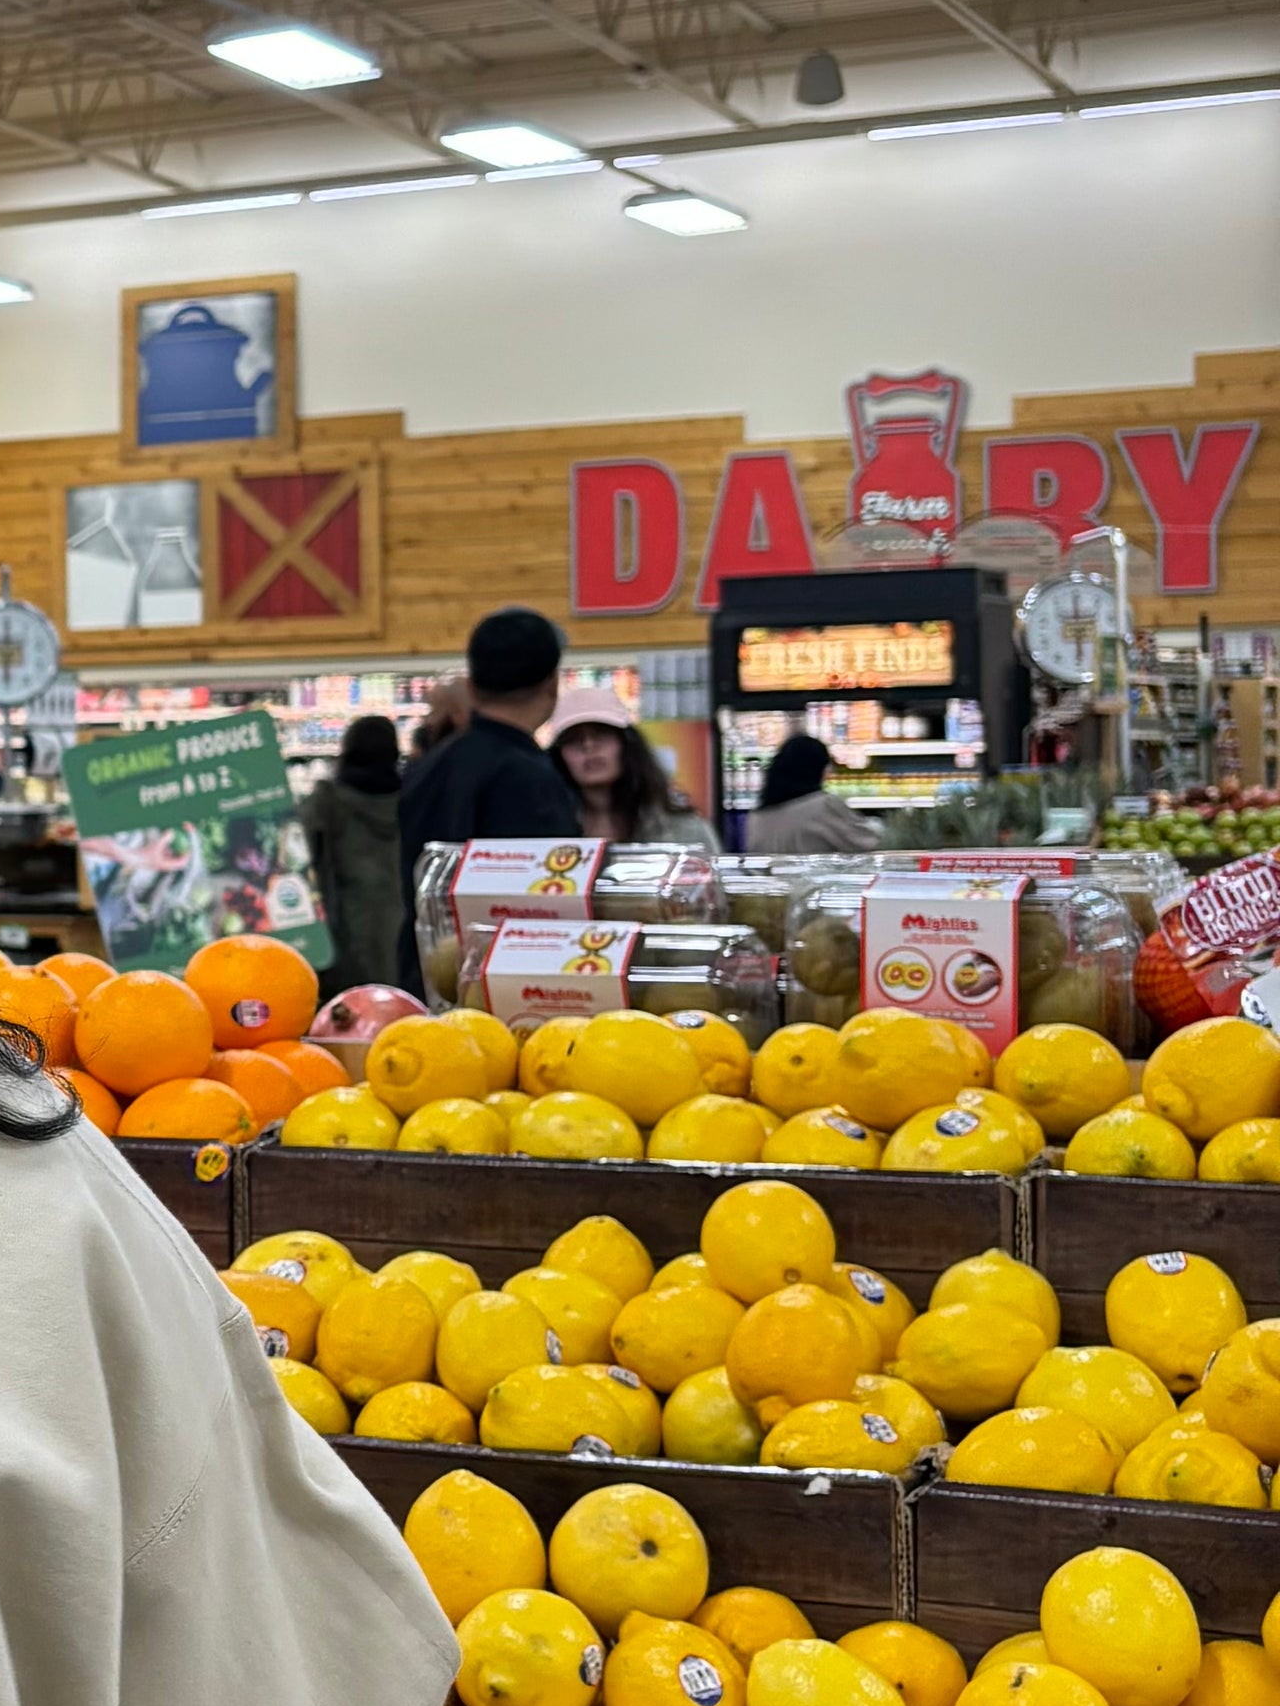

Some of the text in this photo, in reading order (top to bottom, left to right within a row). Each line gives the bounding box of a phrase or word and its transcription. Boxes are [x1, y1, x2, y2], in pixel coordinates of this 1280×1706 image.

[87, 721, 264, 786] ORGANIC PRODUCE
[902, 912, 979, 933] Mighties
[1189, 865, 1279, 924] BLOOD
